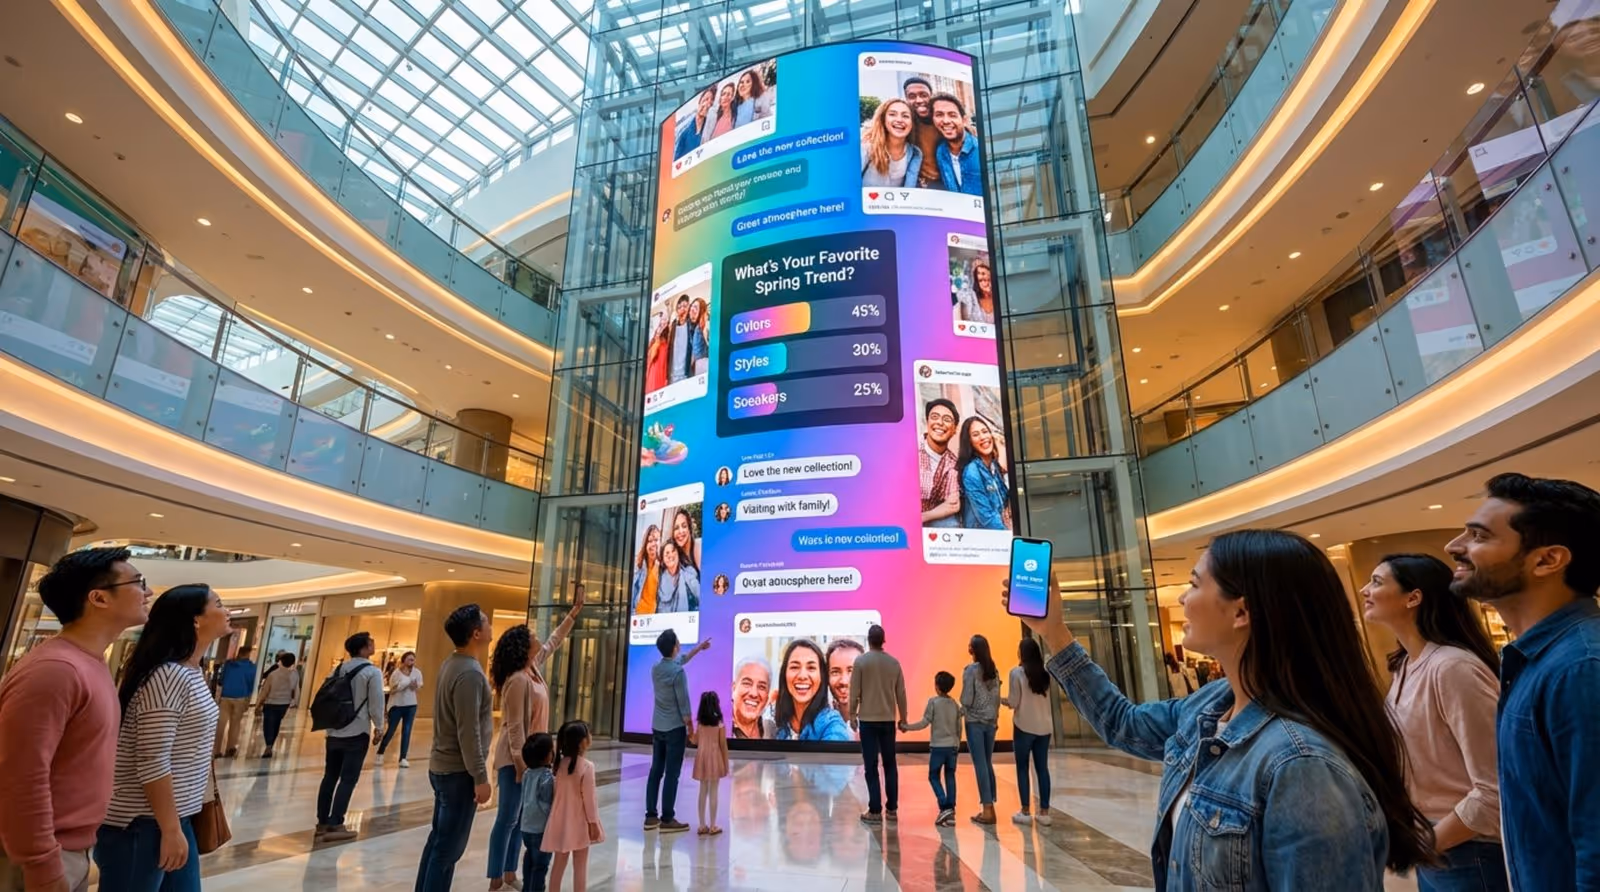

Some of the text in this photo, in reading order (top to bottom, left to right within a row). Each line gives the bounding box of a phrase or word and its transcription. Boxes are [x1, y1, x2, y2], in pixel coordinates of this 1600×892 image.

[735, 246, 880, 281] What's Your Favorite
[755, 266, 855, 296] Spring Trend?
[852, 304, 880, 318] 45%
[854, 383, 882, 396] 25%
[743, 468, 764, 478] Love
[767, 465, 781, 476] the
[783, 465, 802, 474] new
[799, 499, 830, 513] family!
[827, 574, 853, 585] here!
